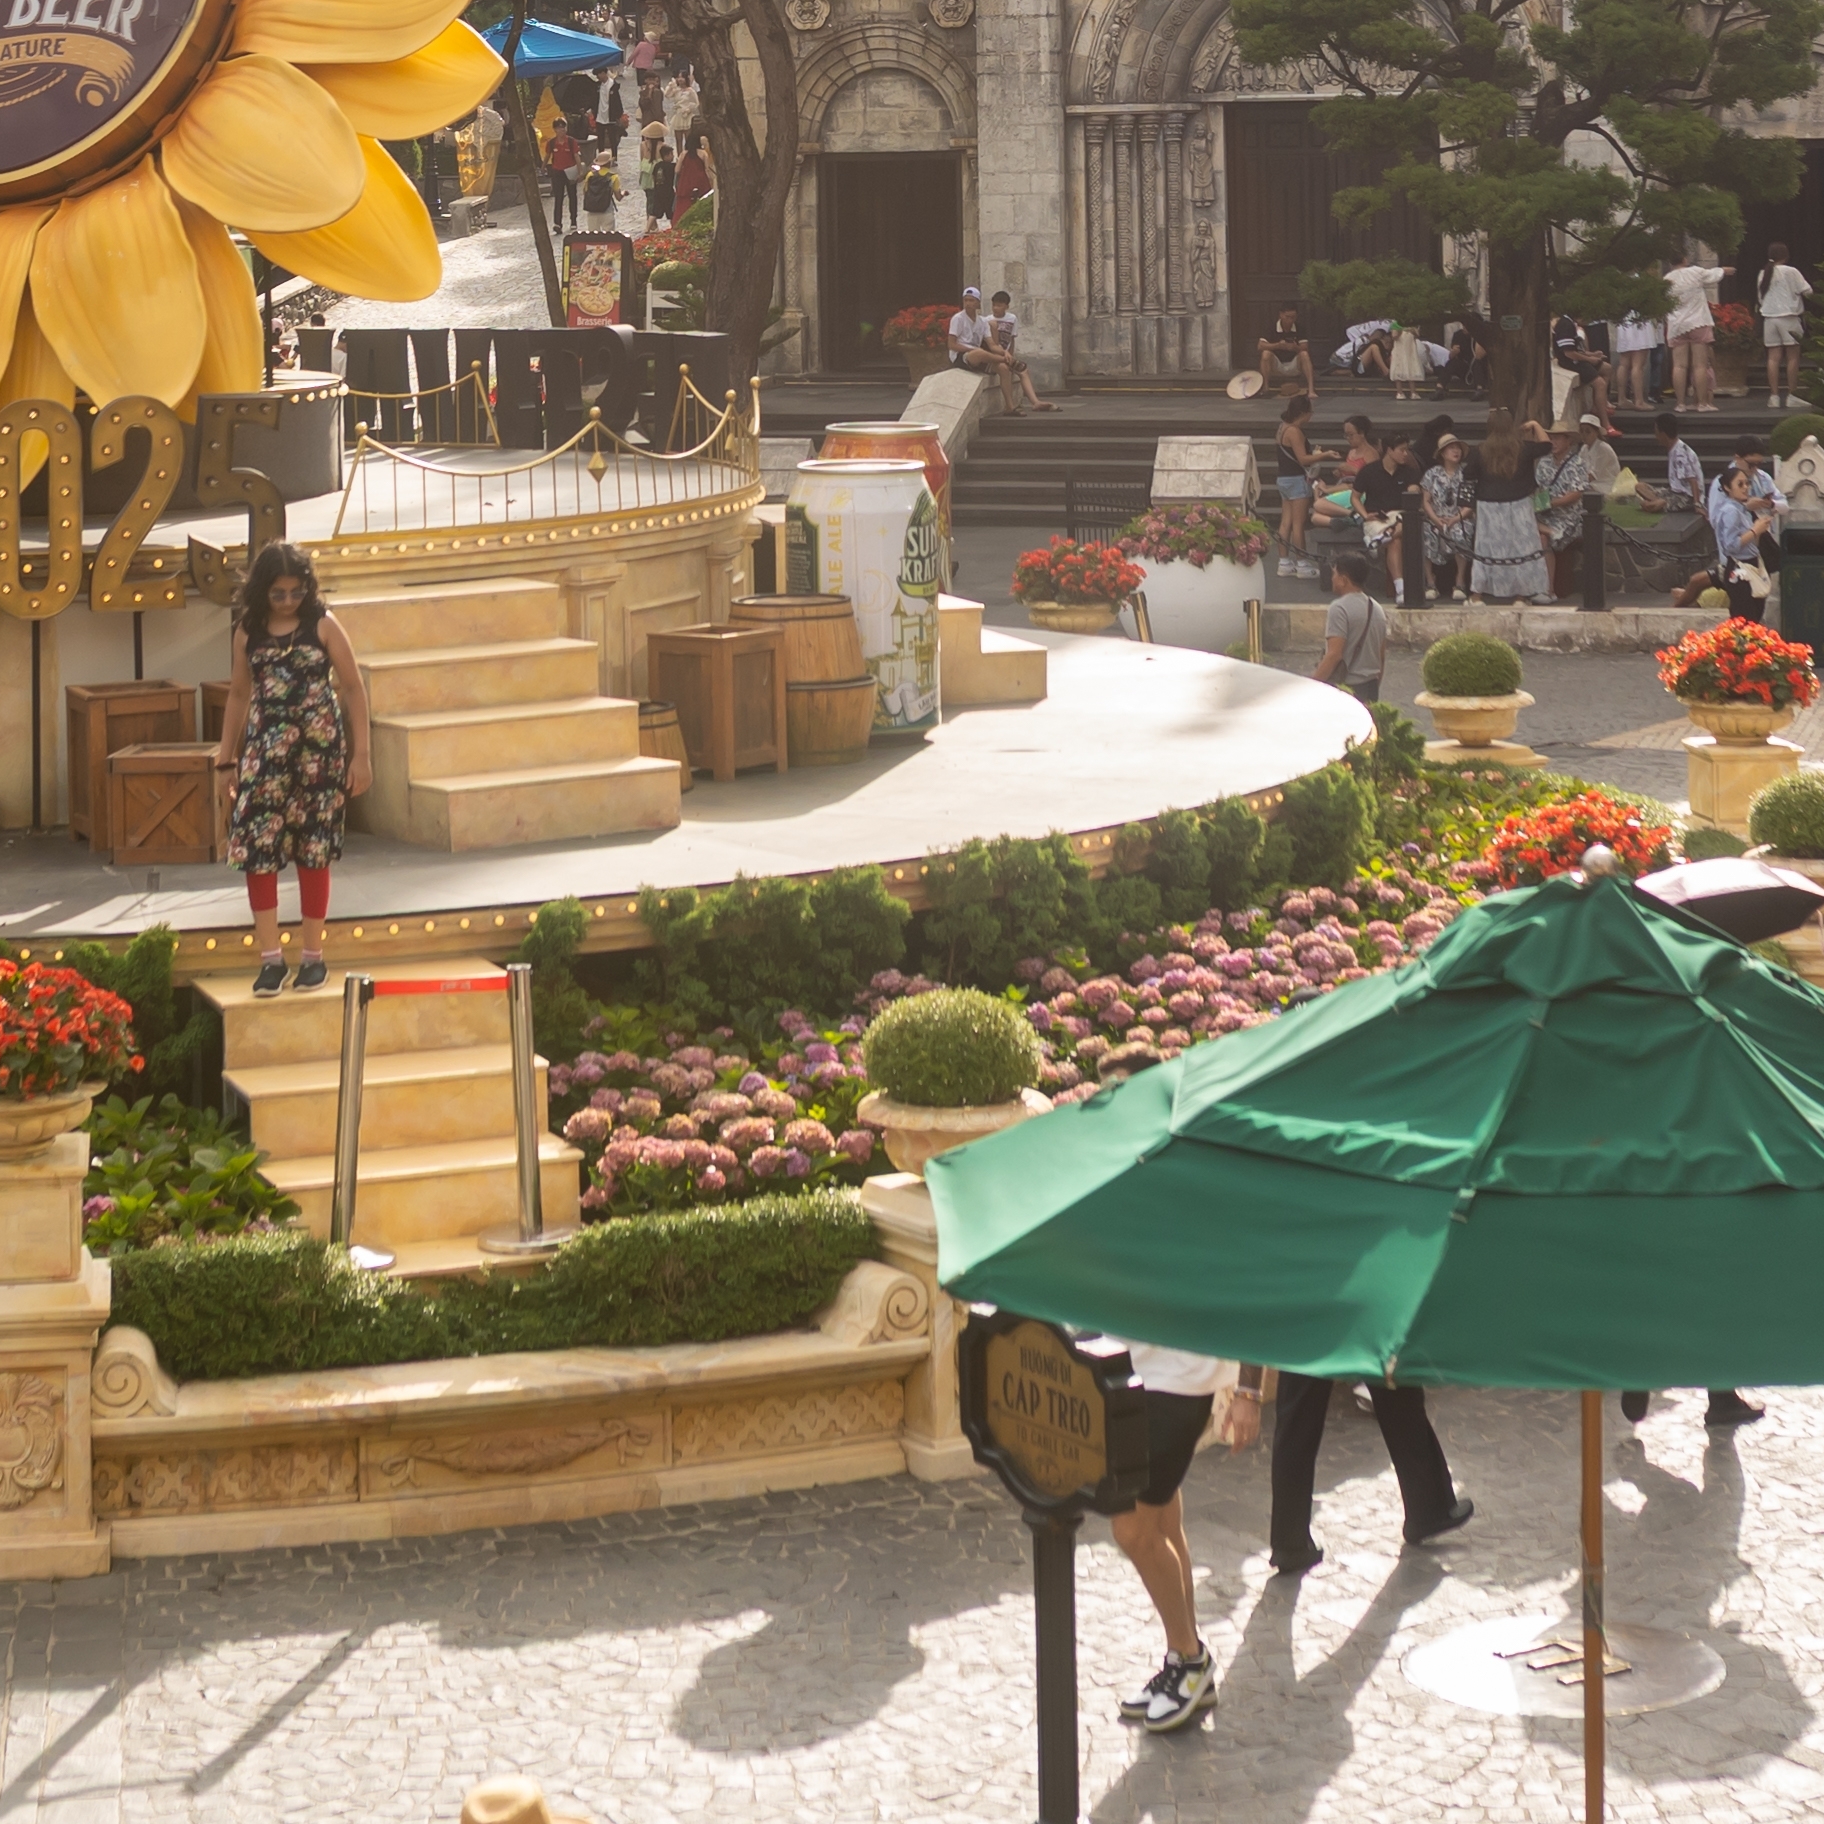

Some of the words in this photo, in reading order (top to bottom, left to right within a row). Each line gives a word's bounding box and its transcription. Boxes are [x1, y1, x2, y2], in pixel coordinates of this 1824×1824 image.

[576, 316, 613, 326] Brasserie
[826, 514, 842, 554] ALE
[1045, 1386, 1091, 1440] TREO
